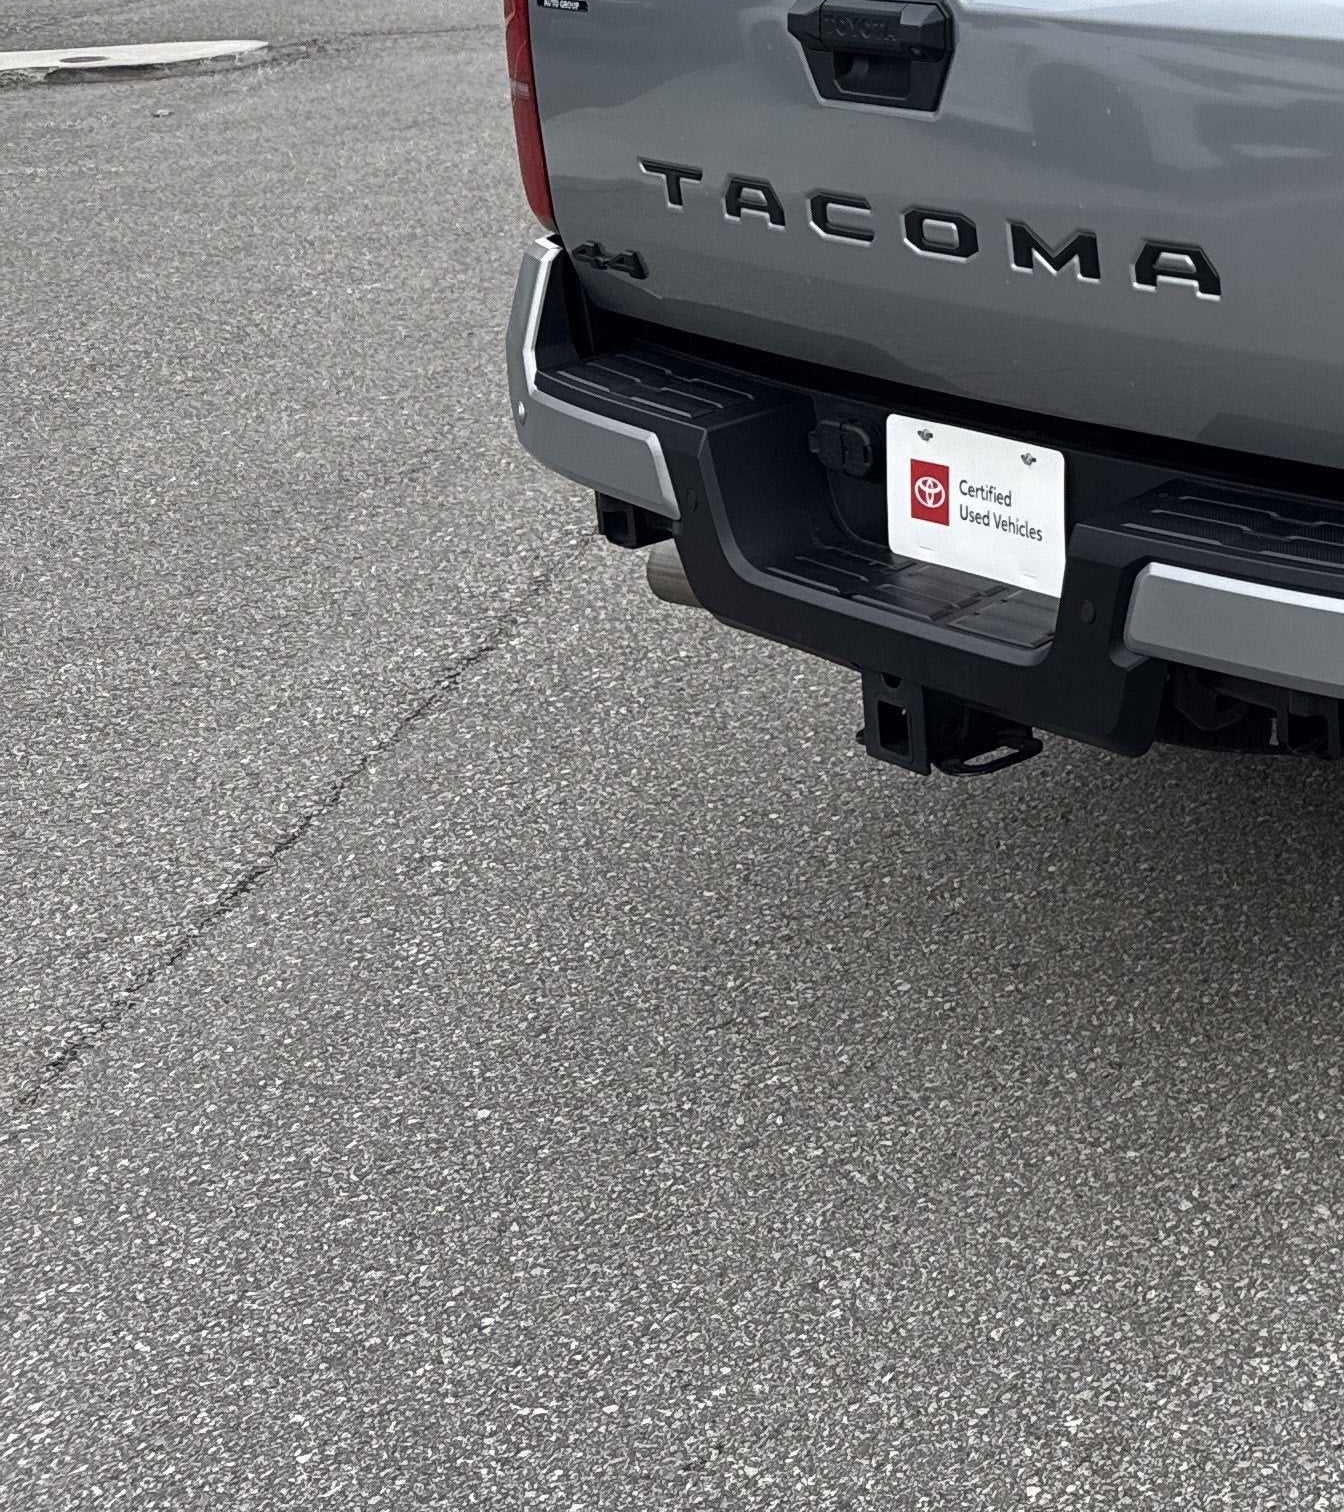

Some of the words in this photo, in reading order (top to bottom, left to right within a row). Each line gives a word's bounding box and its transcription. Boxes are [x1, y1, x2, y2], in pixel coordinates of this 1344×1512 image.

[822, 13, 899, 42] TOYOTA
[637, 156, 1221, 300] TACOMA
[958, 479, 1012, 507] Certified
[959, 504, 990, 527] Used
[993, 512, 1043, 542] Vehicles
